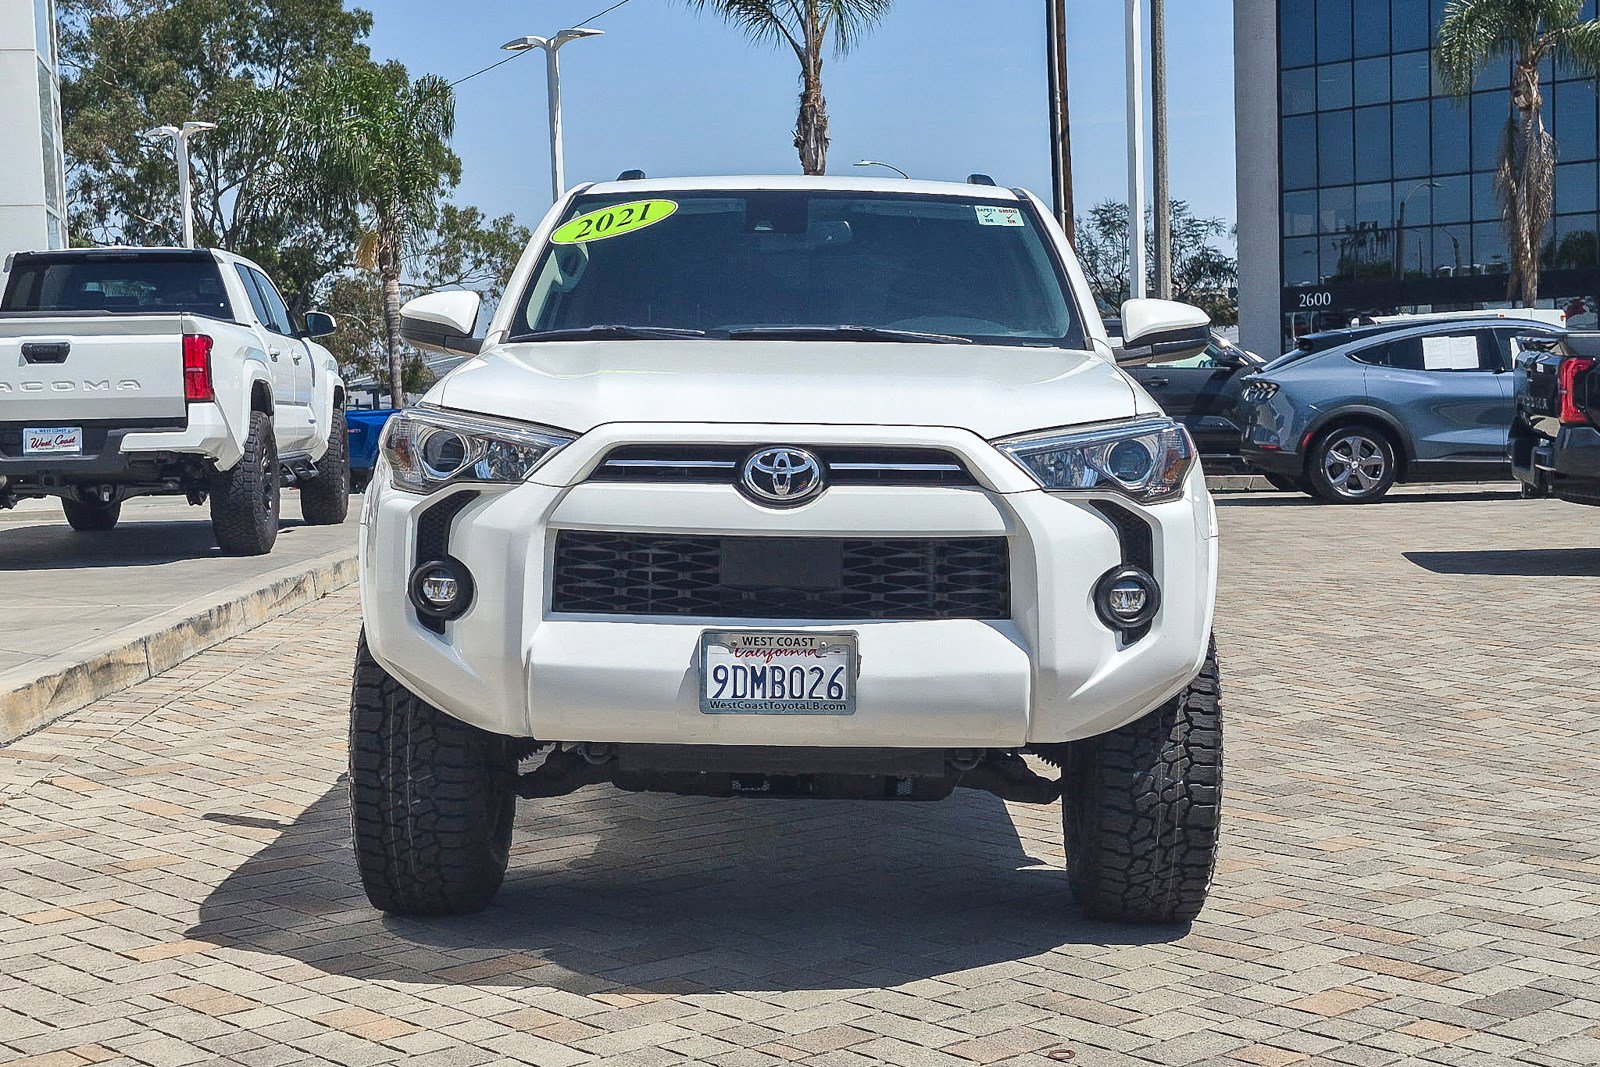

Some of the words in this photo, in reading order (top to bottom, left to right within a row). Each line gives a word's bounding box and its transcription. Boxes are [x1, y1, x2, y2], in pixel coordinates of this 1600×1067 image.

[574, 203, 651, 239] 2021
[1299, 291, 1331, 307] 2600
[30, 438, 52, 448] West
[55, 435, 76, 445] Coast
[742, 636, 774, 647] WEST
[776, 636, 815, 647] COAST
[734, 647, 827, 664] California
[712, 664, 845, 700] 9DMB026
[709, 700, 847, 711] WestCoastToyotaLB.com
